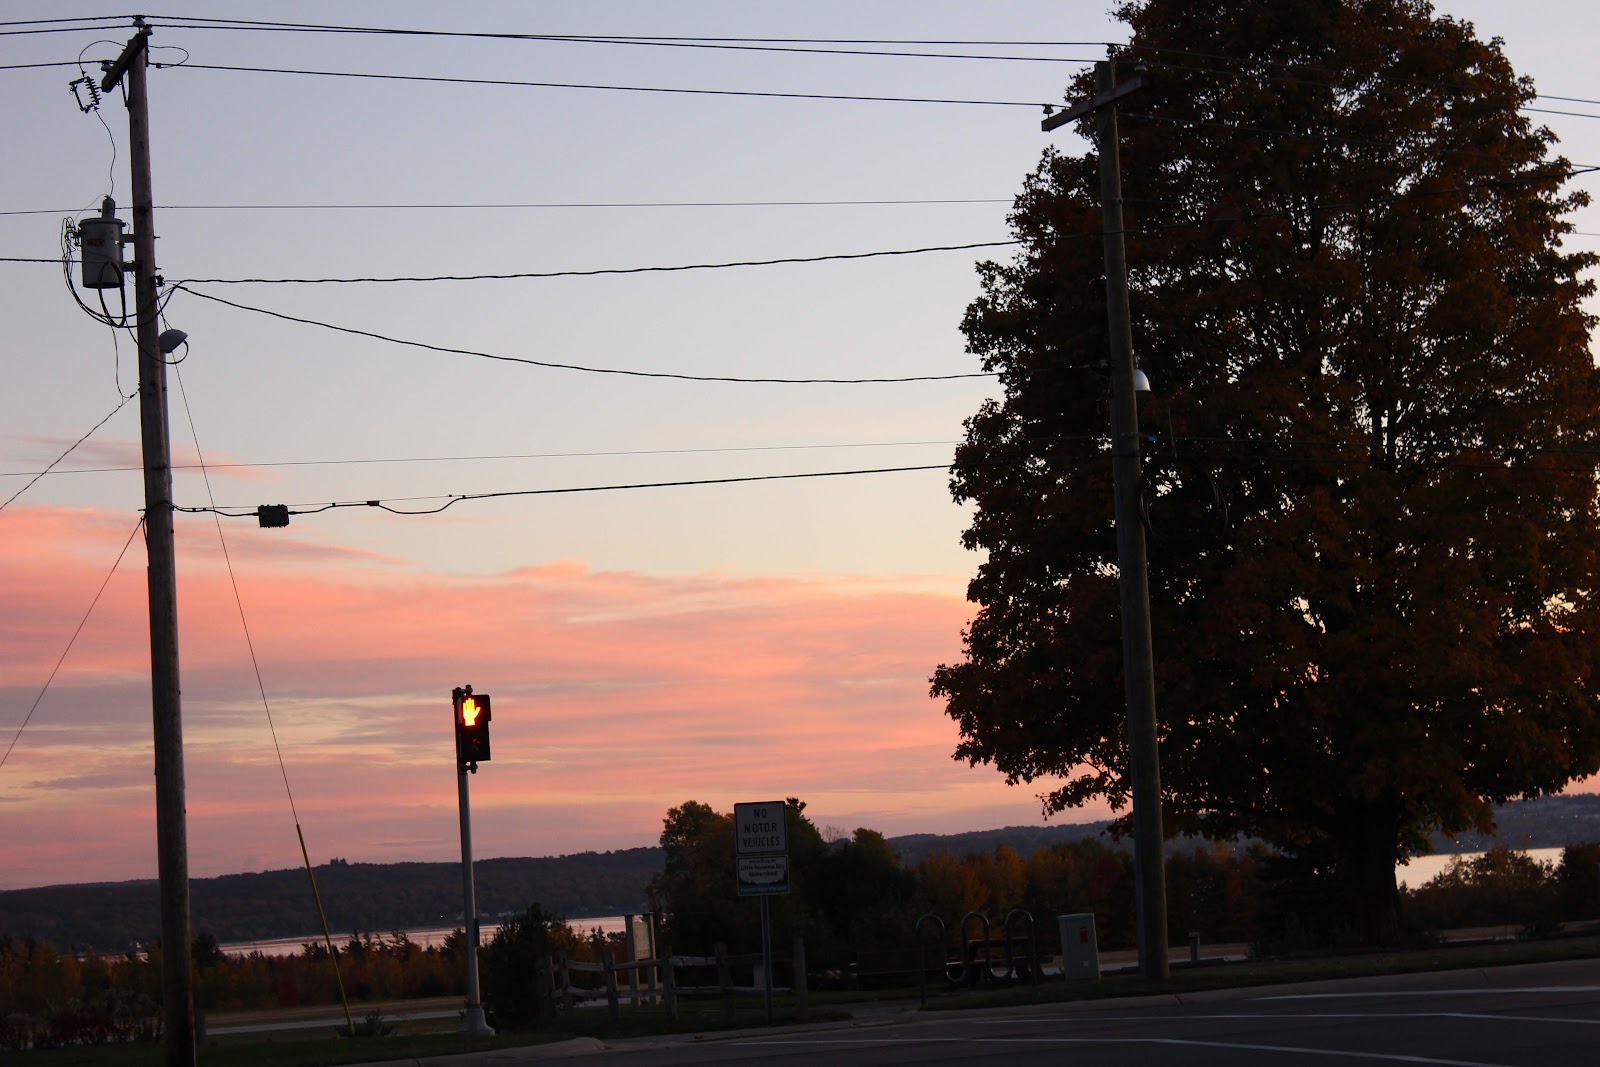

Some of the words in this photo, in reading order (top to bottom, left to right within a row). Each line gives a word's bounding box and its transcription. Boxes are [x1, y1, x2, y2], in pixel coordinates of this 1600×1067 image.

[754, 808, 767, 818] NO
[744, 822, 777, 834] MOTOR
[743, 836, 780, 847] VEHICLES
